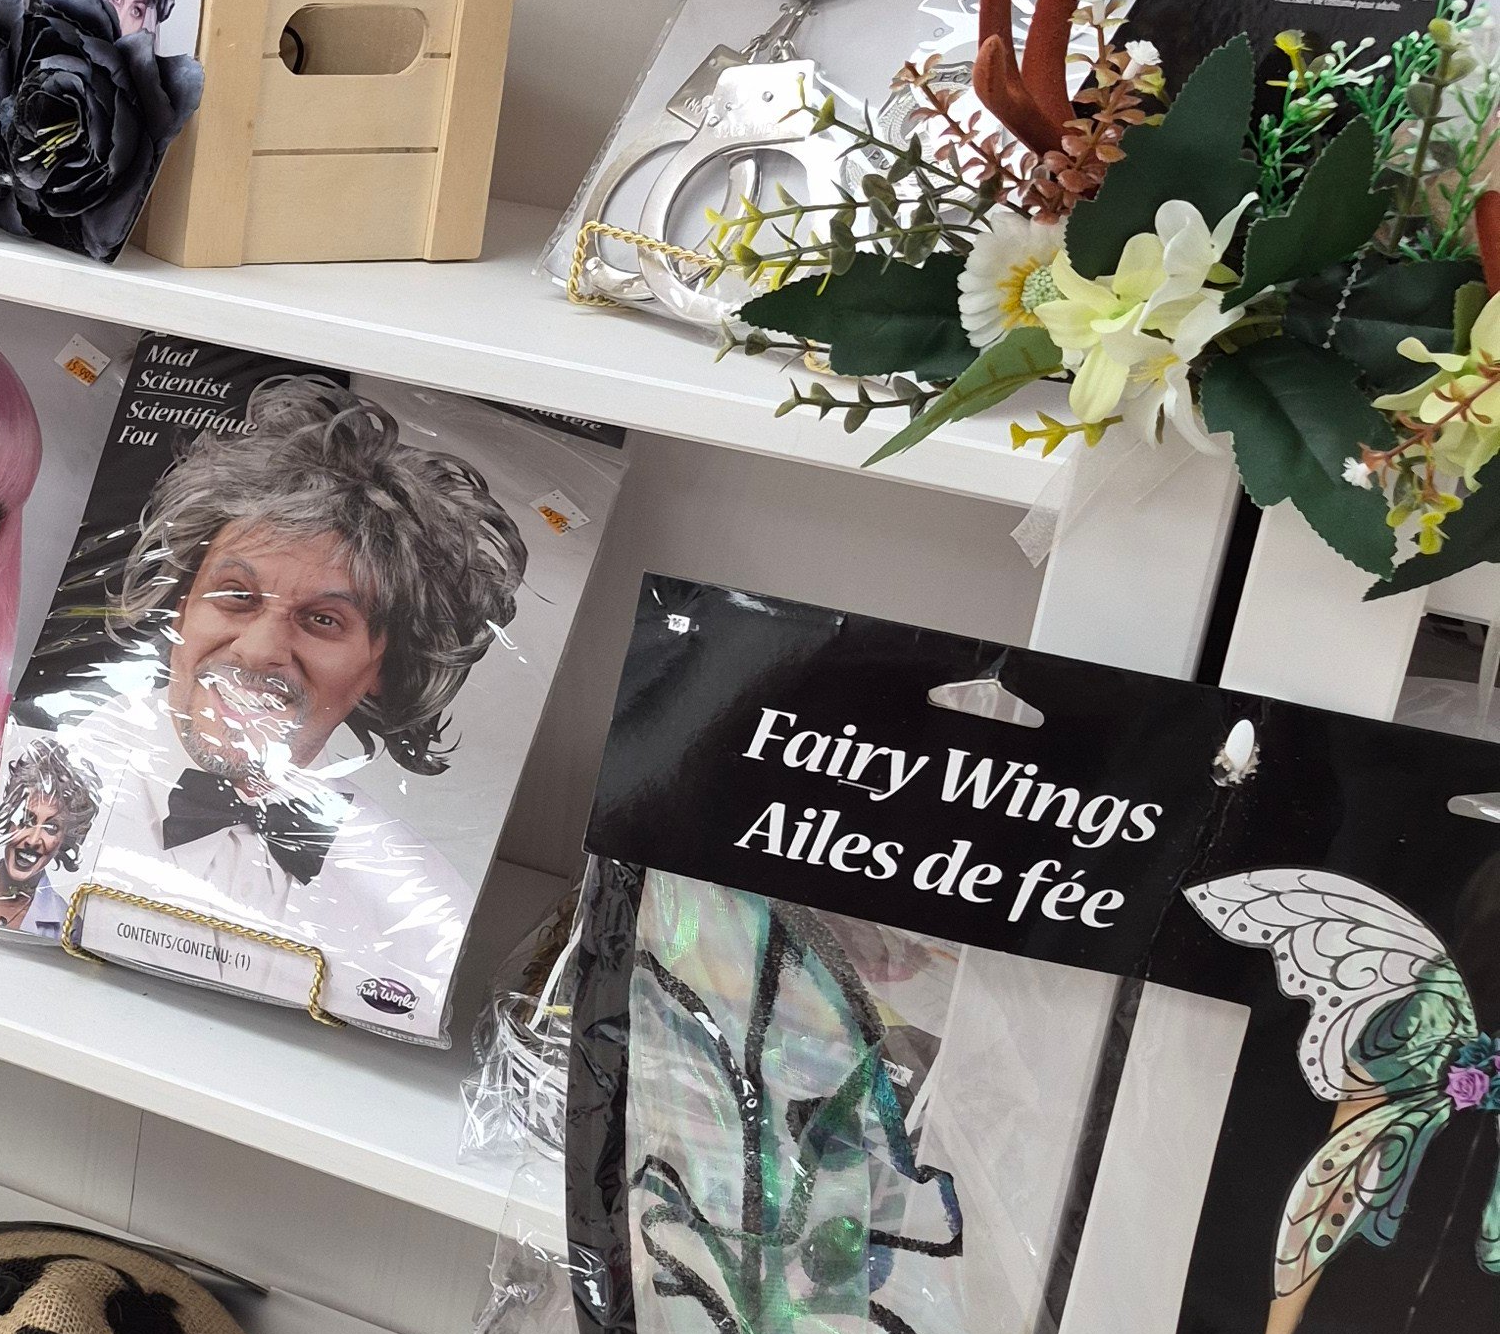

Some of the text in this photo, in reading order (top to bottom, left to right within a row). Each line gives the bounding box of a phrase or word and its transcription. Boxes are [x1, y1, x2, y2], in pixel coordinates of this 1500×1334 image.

[144, 345, 199, 367] Mad
[136, 369, 233, 399] Scientist
[126, 400, 258, 436] Scientifique
[117, 425, 159, 447] Fou
[741, 706, 1163, 849] Fairy Wings
[734, 802, 1126, 930] Ailes de fée
[116, 922, 251, 971] CONTENTS/CONTENU: (1)
[379, 987, 420, 1010] World
